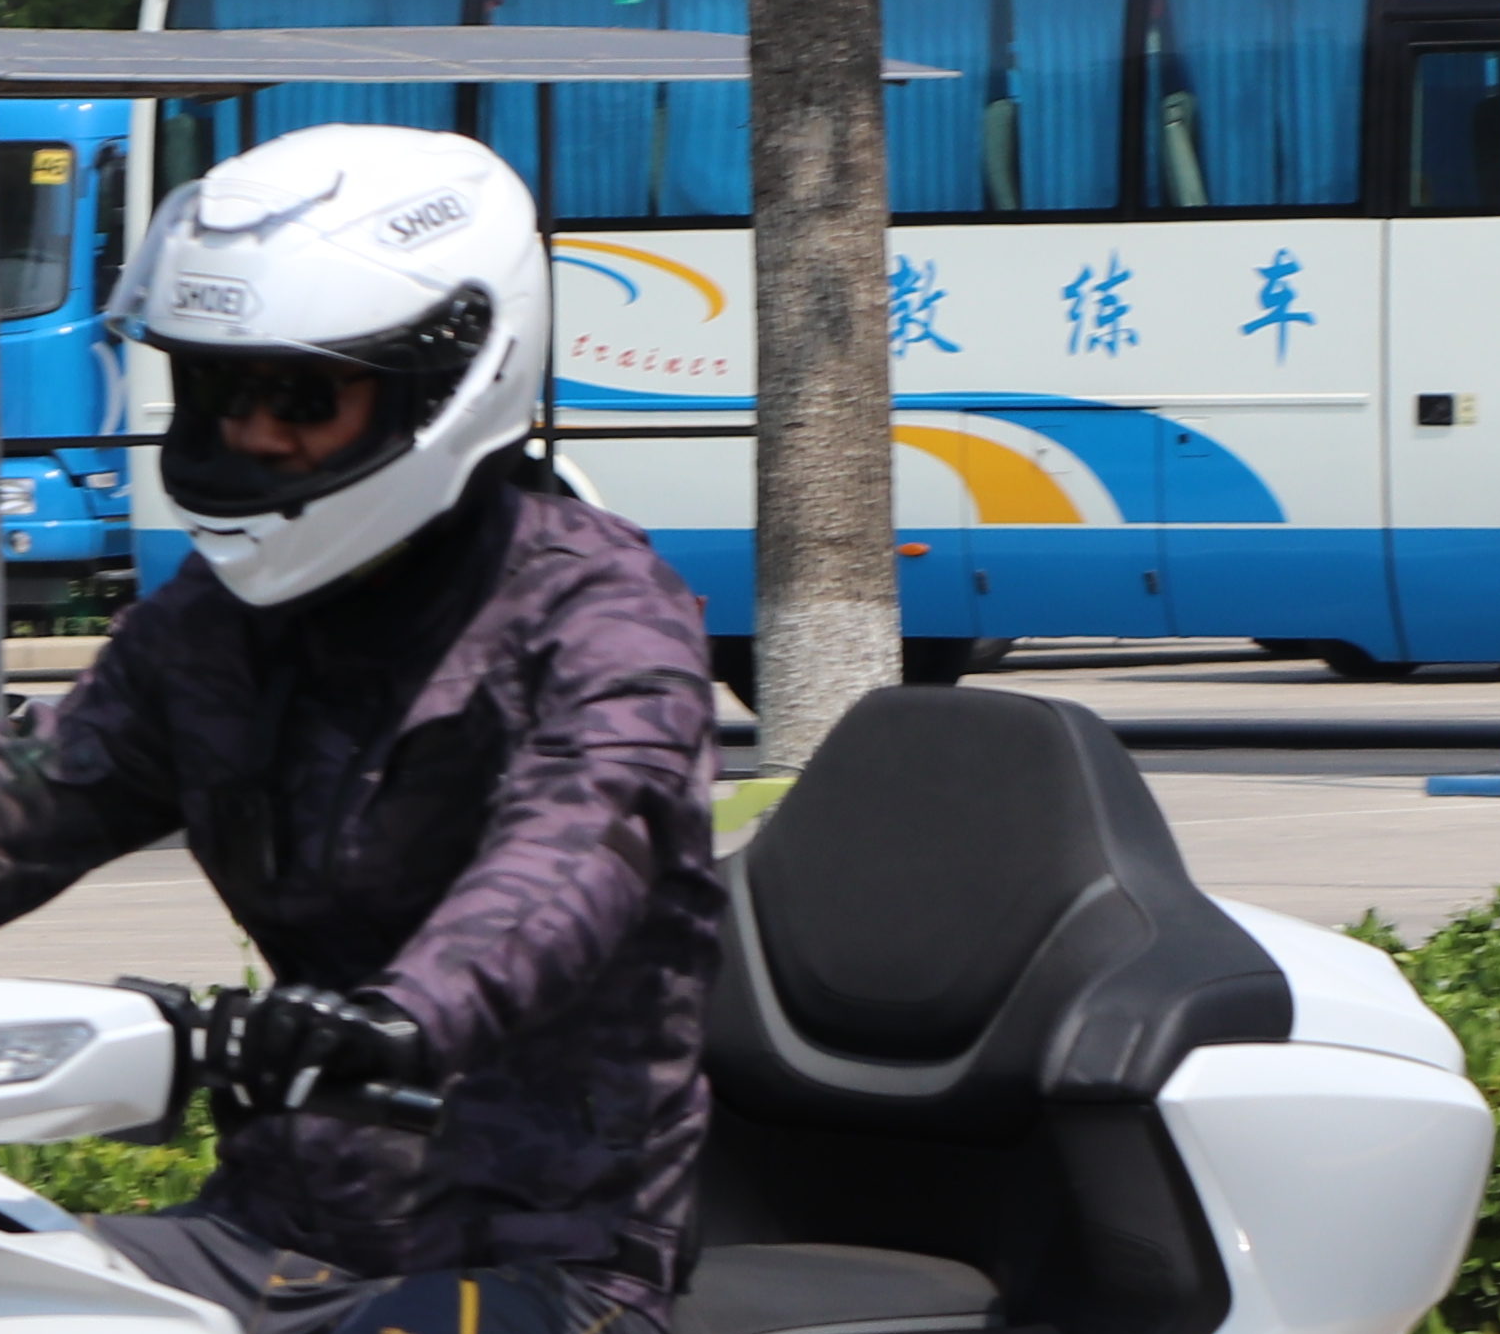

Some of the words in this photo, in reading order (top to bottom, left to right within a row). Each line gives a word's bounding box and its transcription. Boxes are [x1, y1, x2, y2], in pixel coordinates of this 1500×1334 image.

[387, 194, 469, 245] SHOEI
[174, 280, 244, 317] SHOEI
[886, 243, 1318, 369] 教练车
[570, 332, 730, 377] trainer
